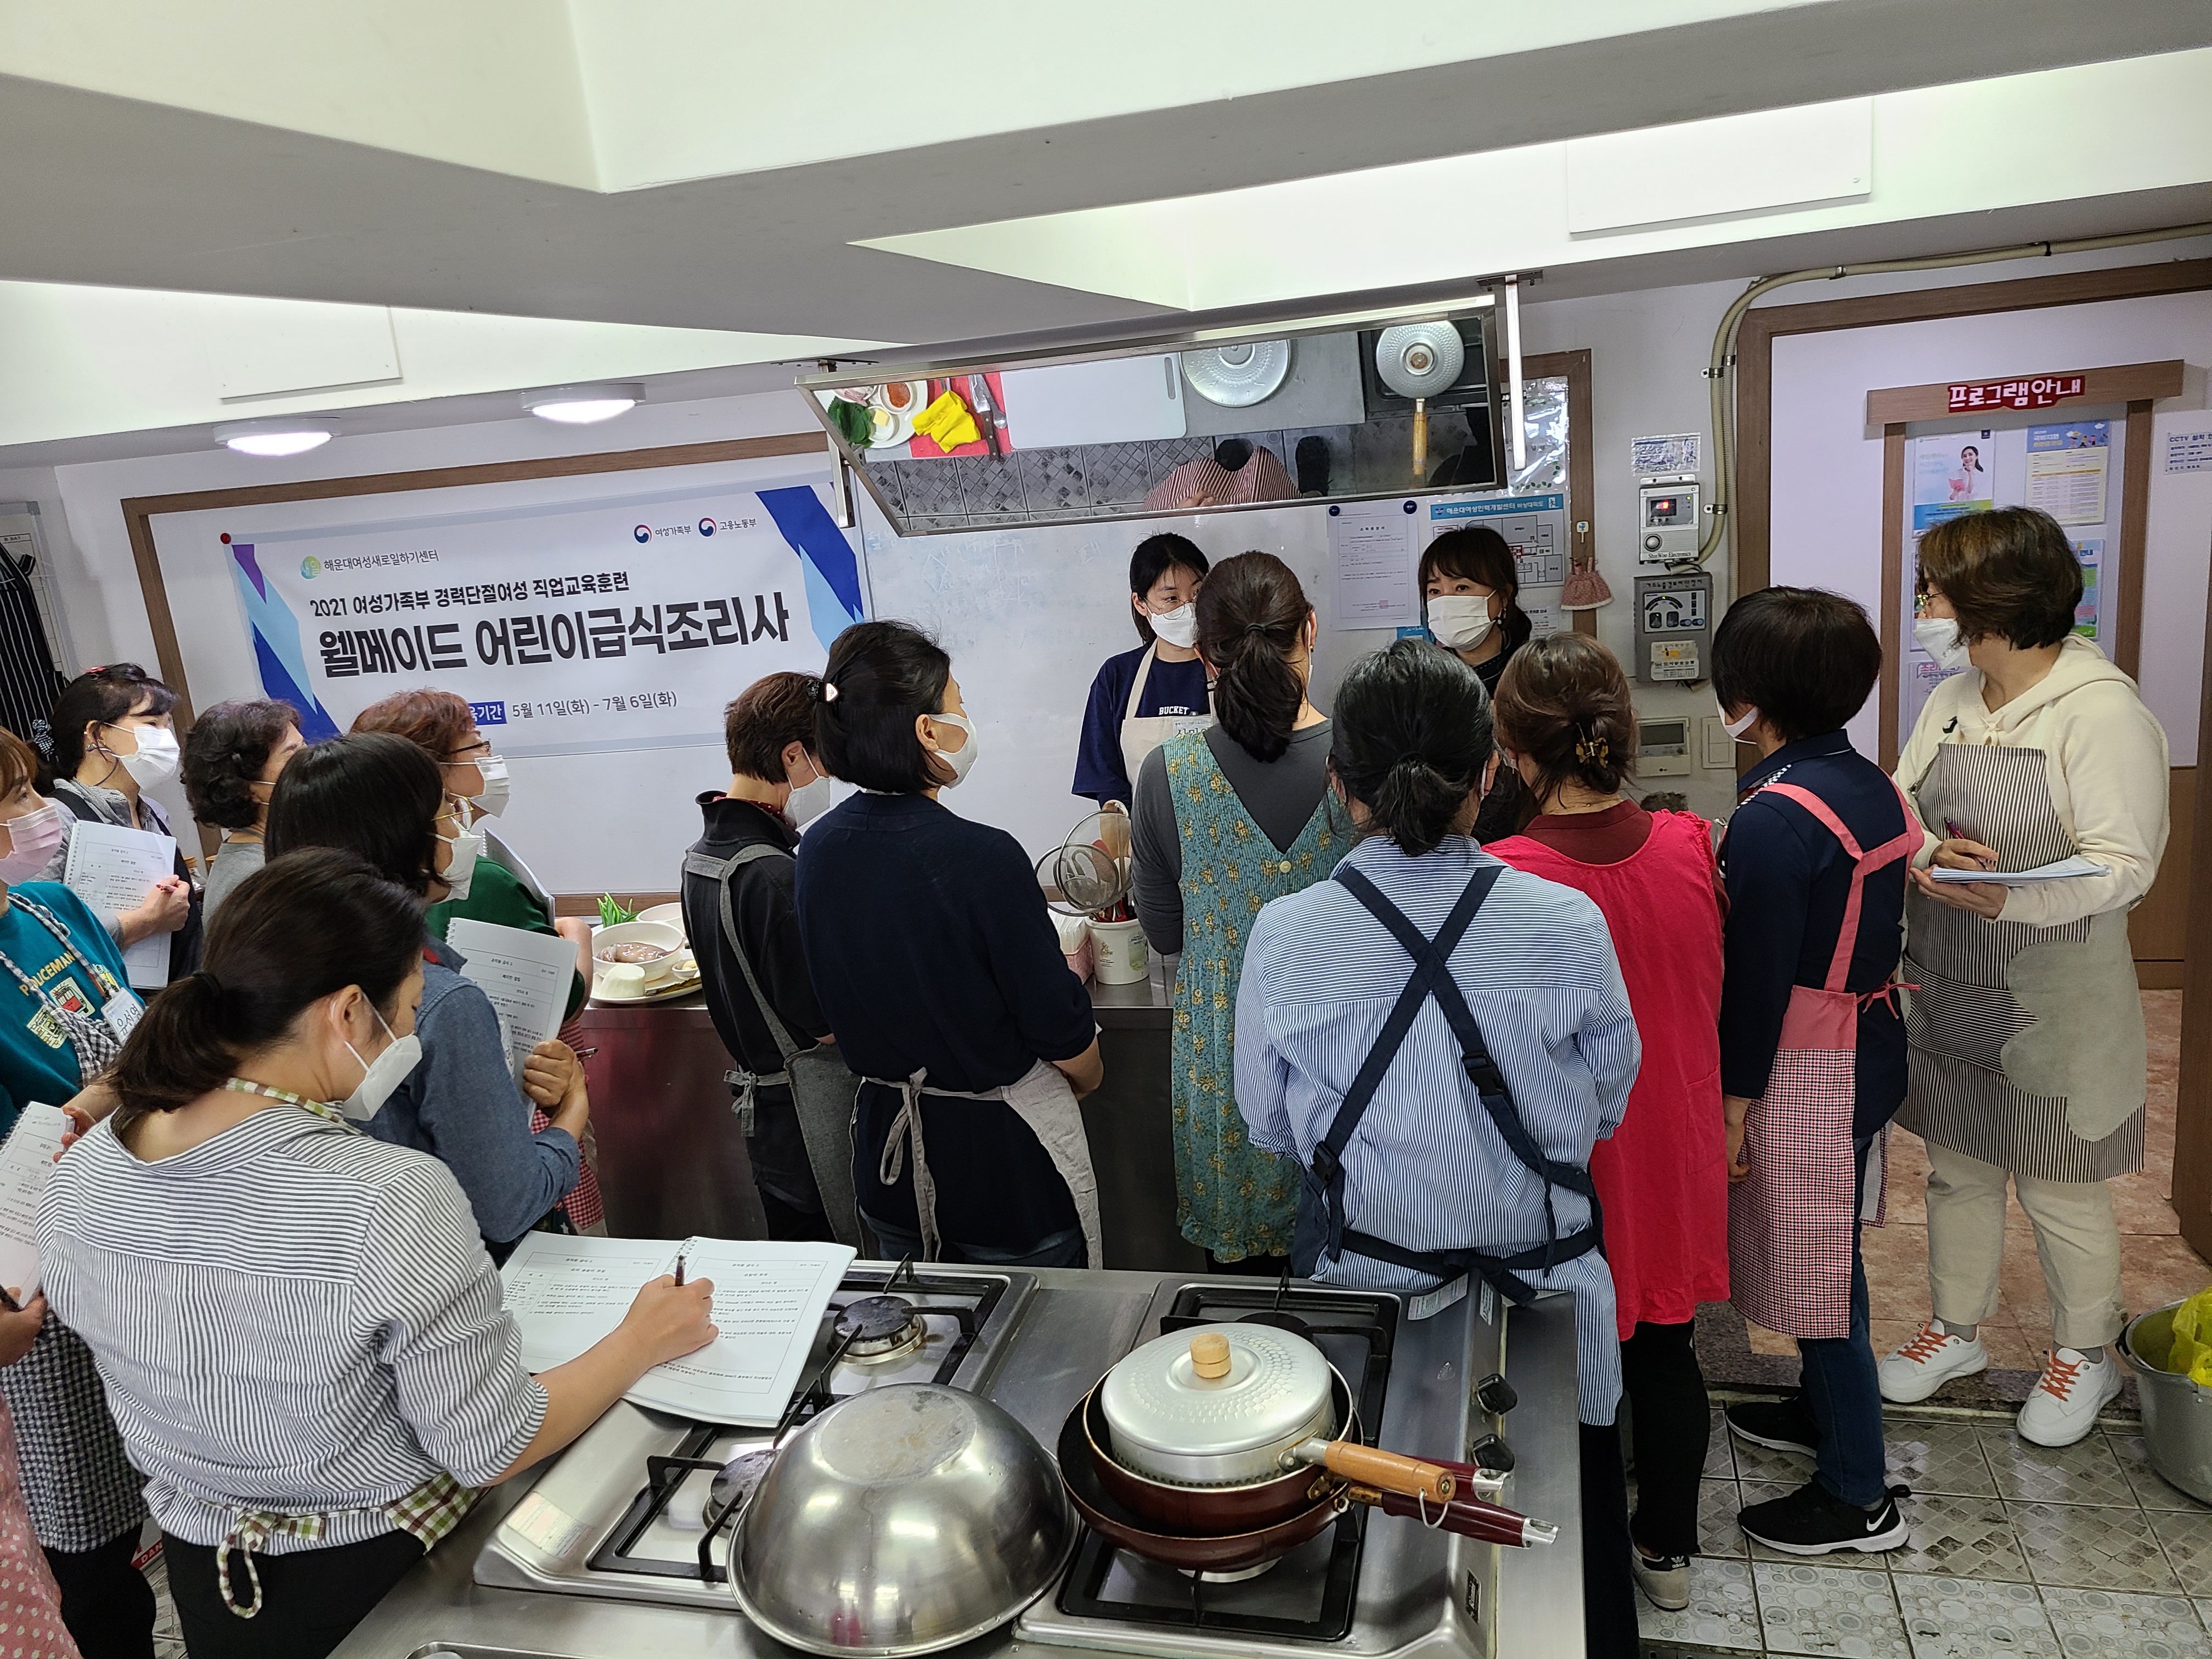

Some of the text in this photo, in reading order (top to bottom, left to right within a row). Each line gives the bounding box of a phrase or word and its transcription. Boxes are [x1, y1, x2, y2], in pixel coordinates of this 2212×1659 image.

[1446, 502, 1516, 515] 해운대여성인력개발센터
[655, 525, 692, 537] 여성가족부
[719, 518, 757, 531] 고용노동부
[323, 549, 440, 572] 해운대여성새로일하기센터
[311, 570, 630, 617] 2021 여성가족부 경력단절여성 직업교육훈련
[319, 591, 790, 679] 웰메이드 어린이급식조리사
[512, 702, 534, 719] 5월
[537, 698, 590, 717] 11일(화)
[602, 695, 627, 712] 7월
[629, 690, 678, 709] 6일(화)
[1158, 706, 1189, 716] BUCKET
[19, 950, 76, 997] PLICEMAN
